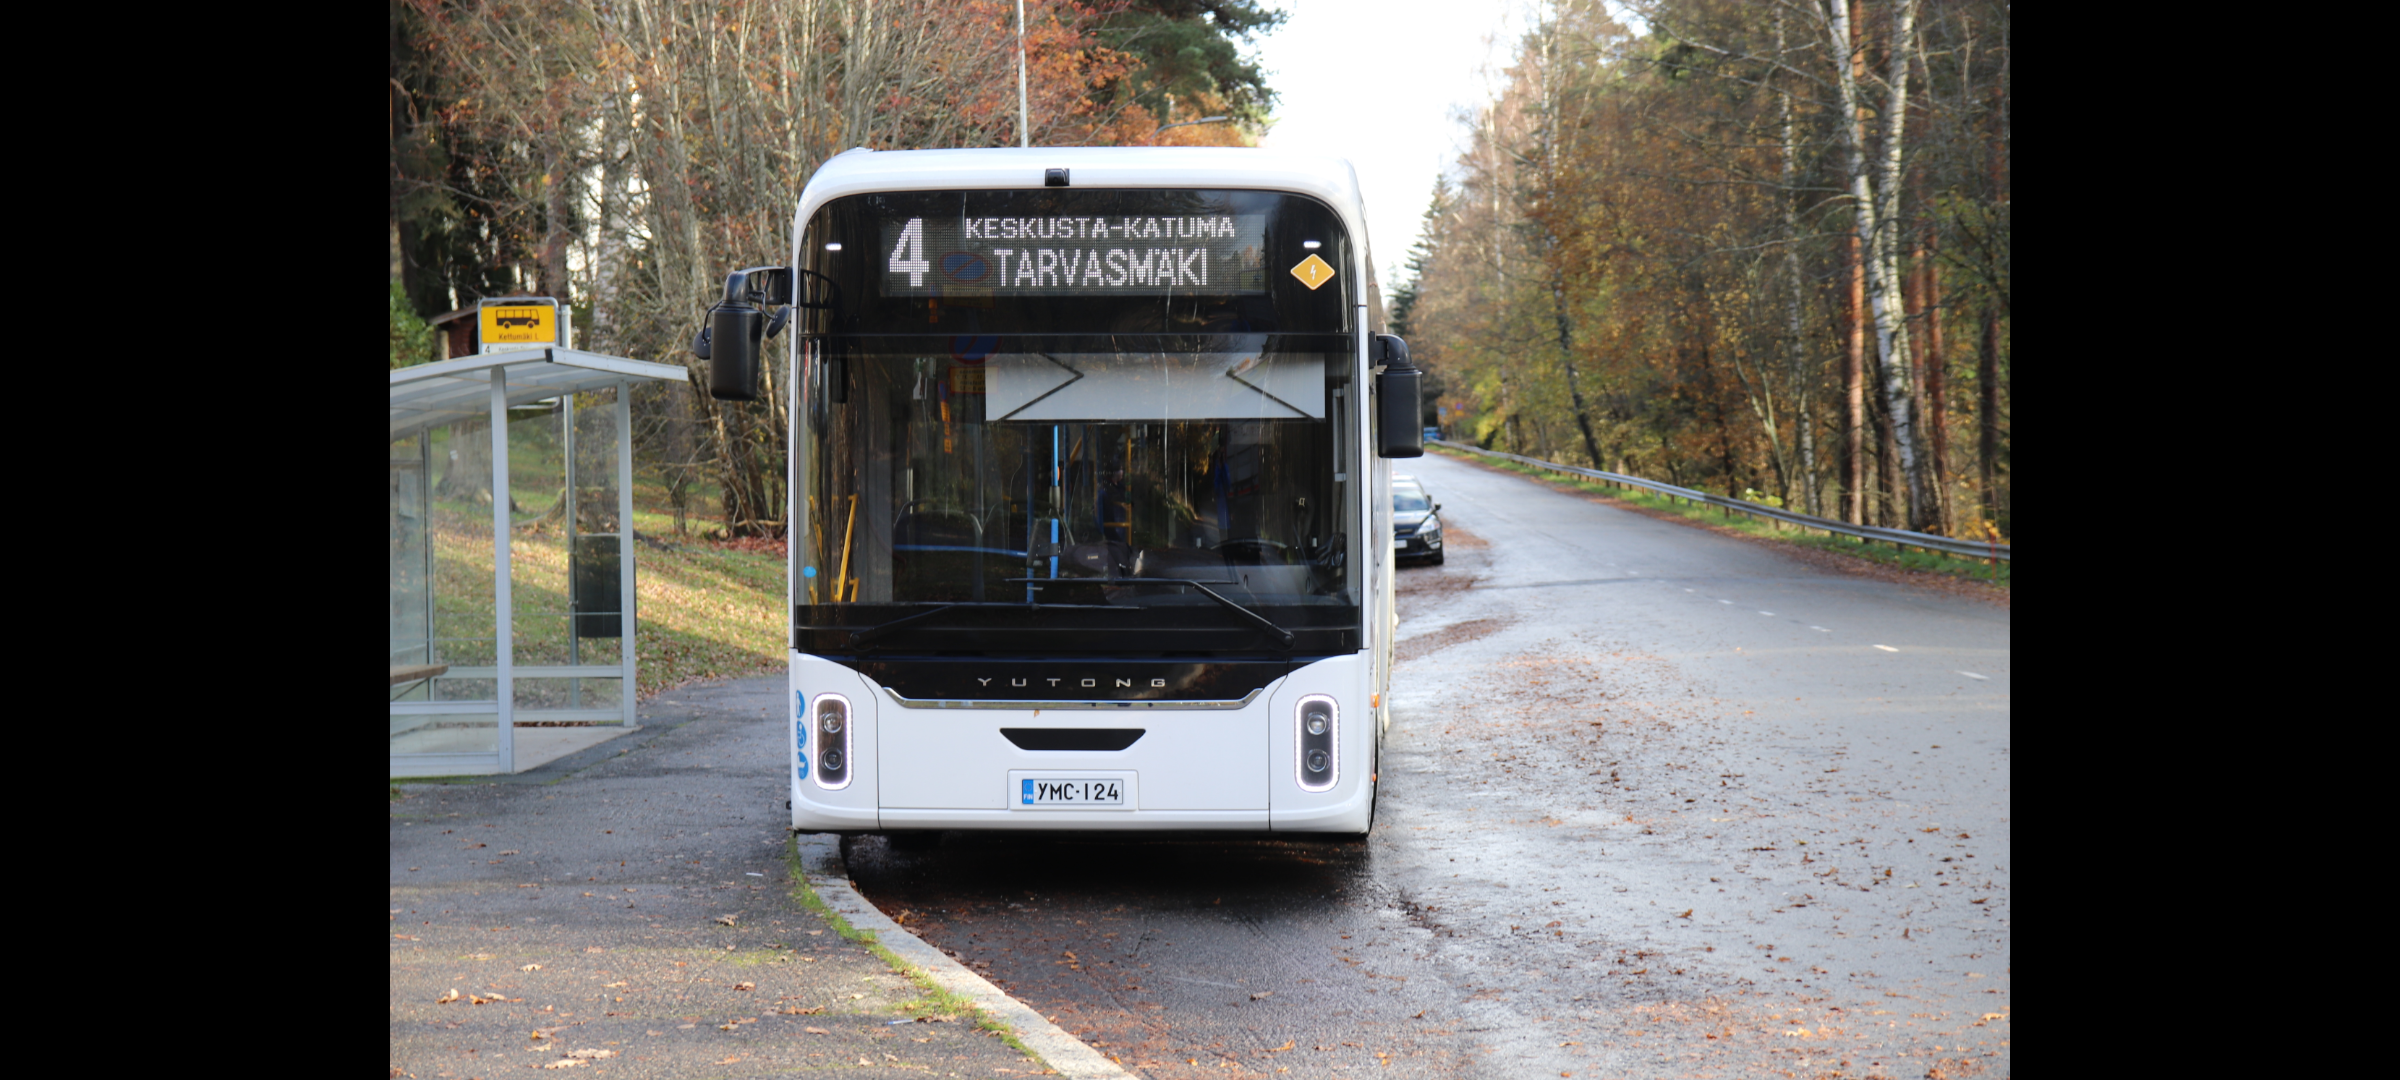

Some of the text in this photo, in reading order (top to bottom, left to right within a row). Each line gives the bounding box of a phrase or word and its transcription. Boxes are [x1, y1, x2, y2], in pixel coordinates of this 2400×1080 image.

[889, 217, 1236, 287] 4 KESKUSTA-KATUMA
[993, 248, 1208, 287] TARVASMÄKI
[977, 677, 1166, 688] YUTONG
